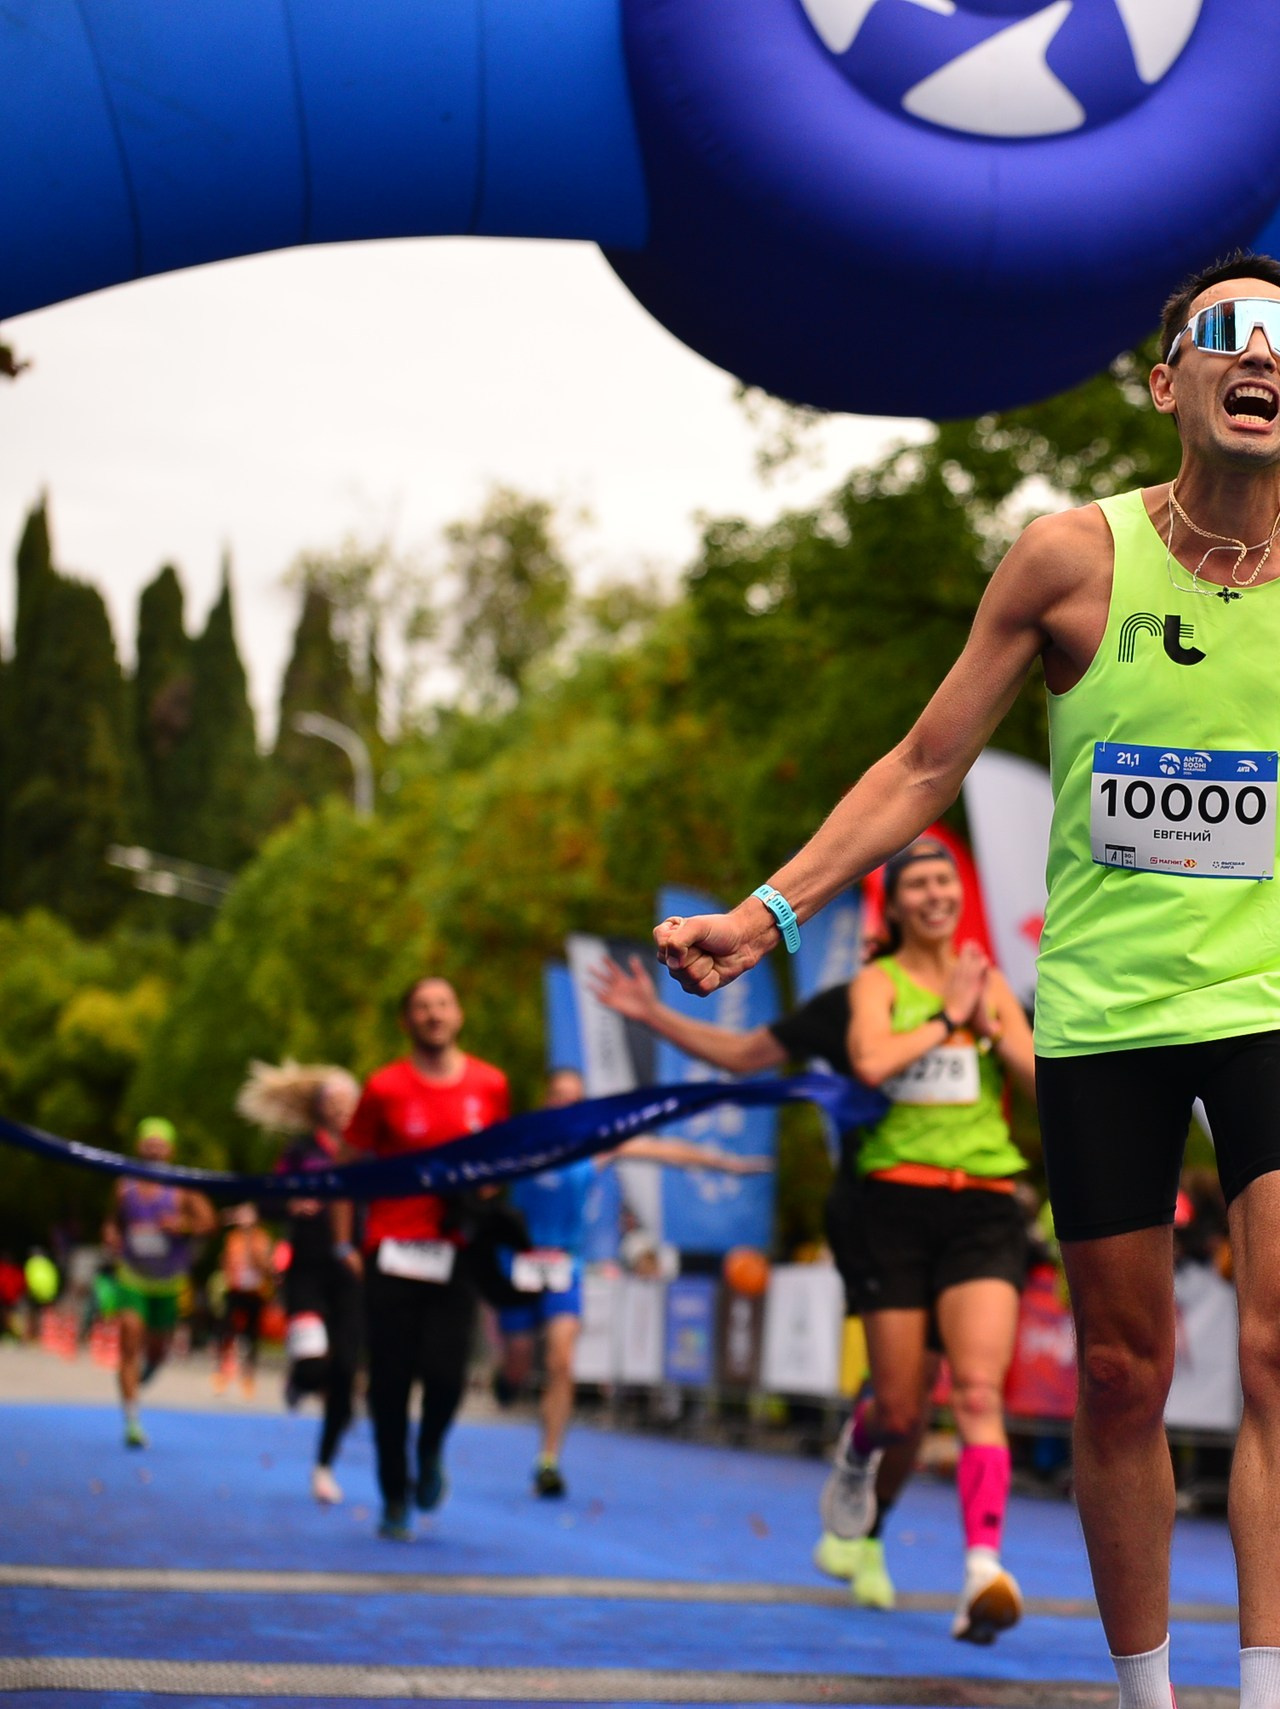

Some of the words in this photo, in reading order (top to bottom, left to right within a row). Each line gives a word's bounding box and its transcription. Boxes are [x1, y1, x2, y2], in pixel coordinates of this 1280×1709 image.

[1117, 752, 1140, 768] 21,1
[1100, 778, 1267, 825] 10000
[1153, 829, 1211, 842] ЕВГЕНИЙ
[1158, 858, 1182, 866] МАГНИТ
